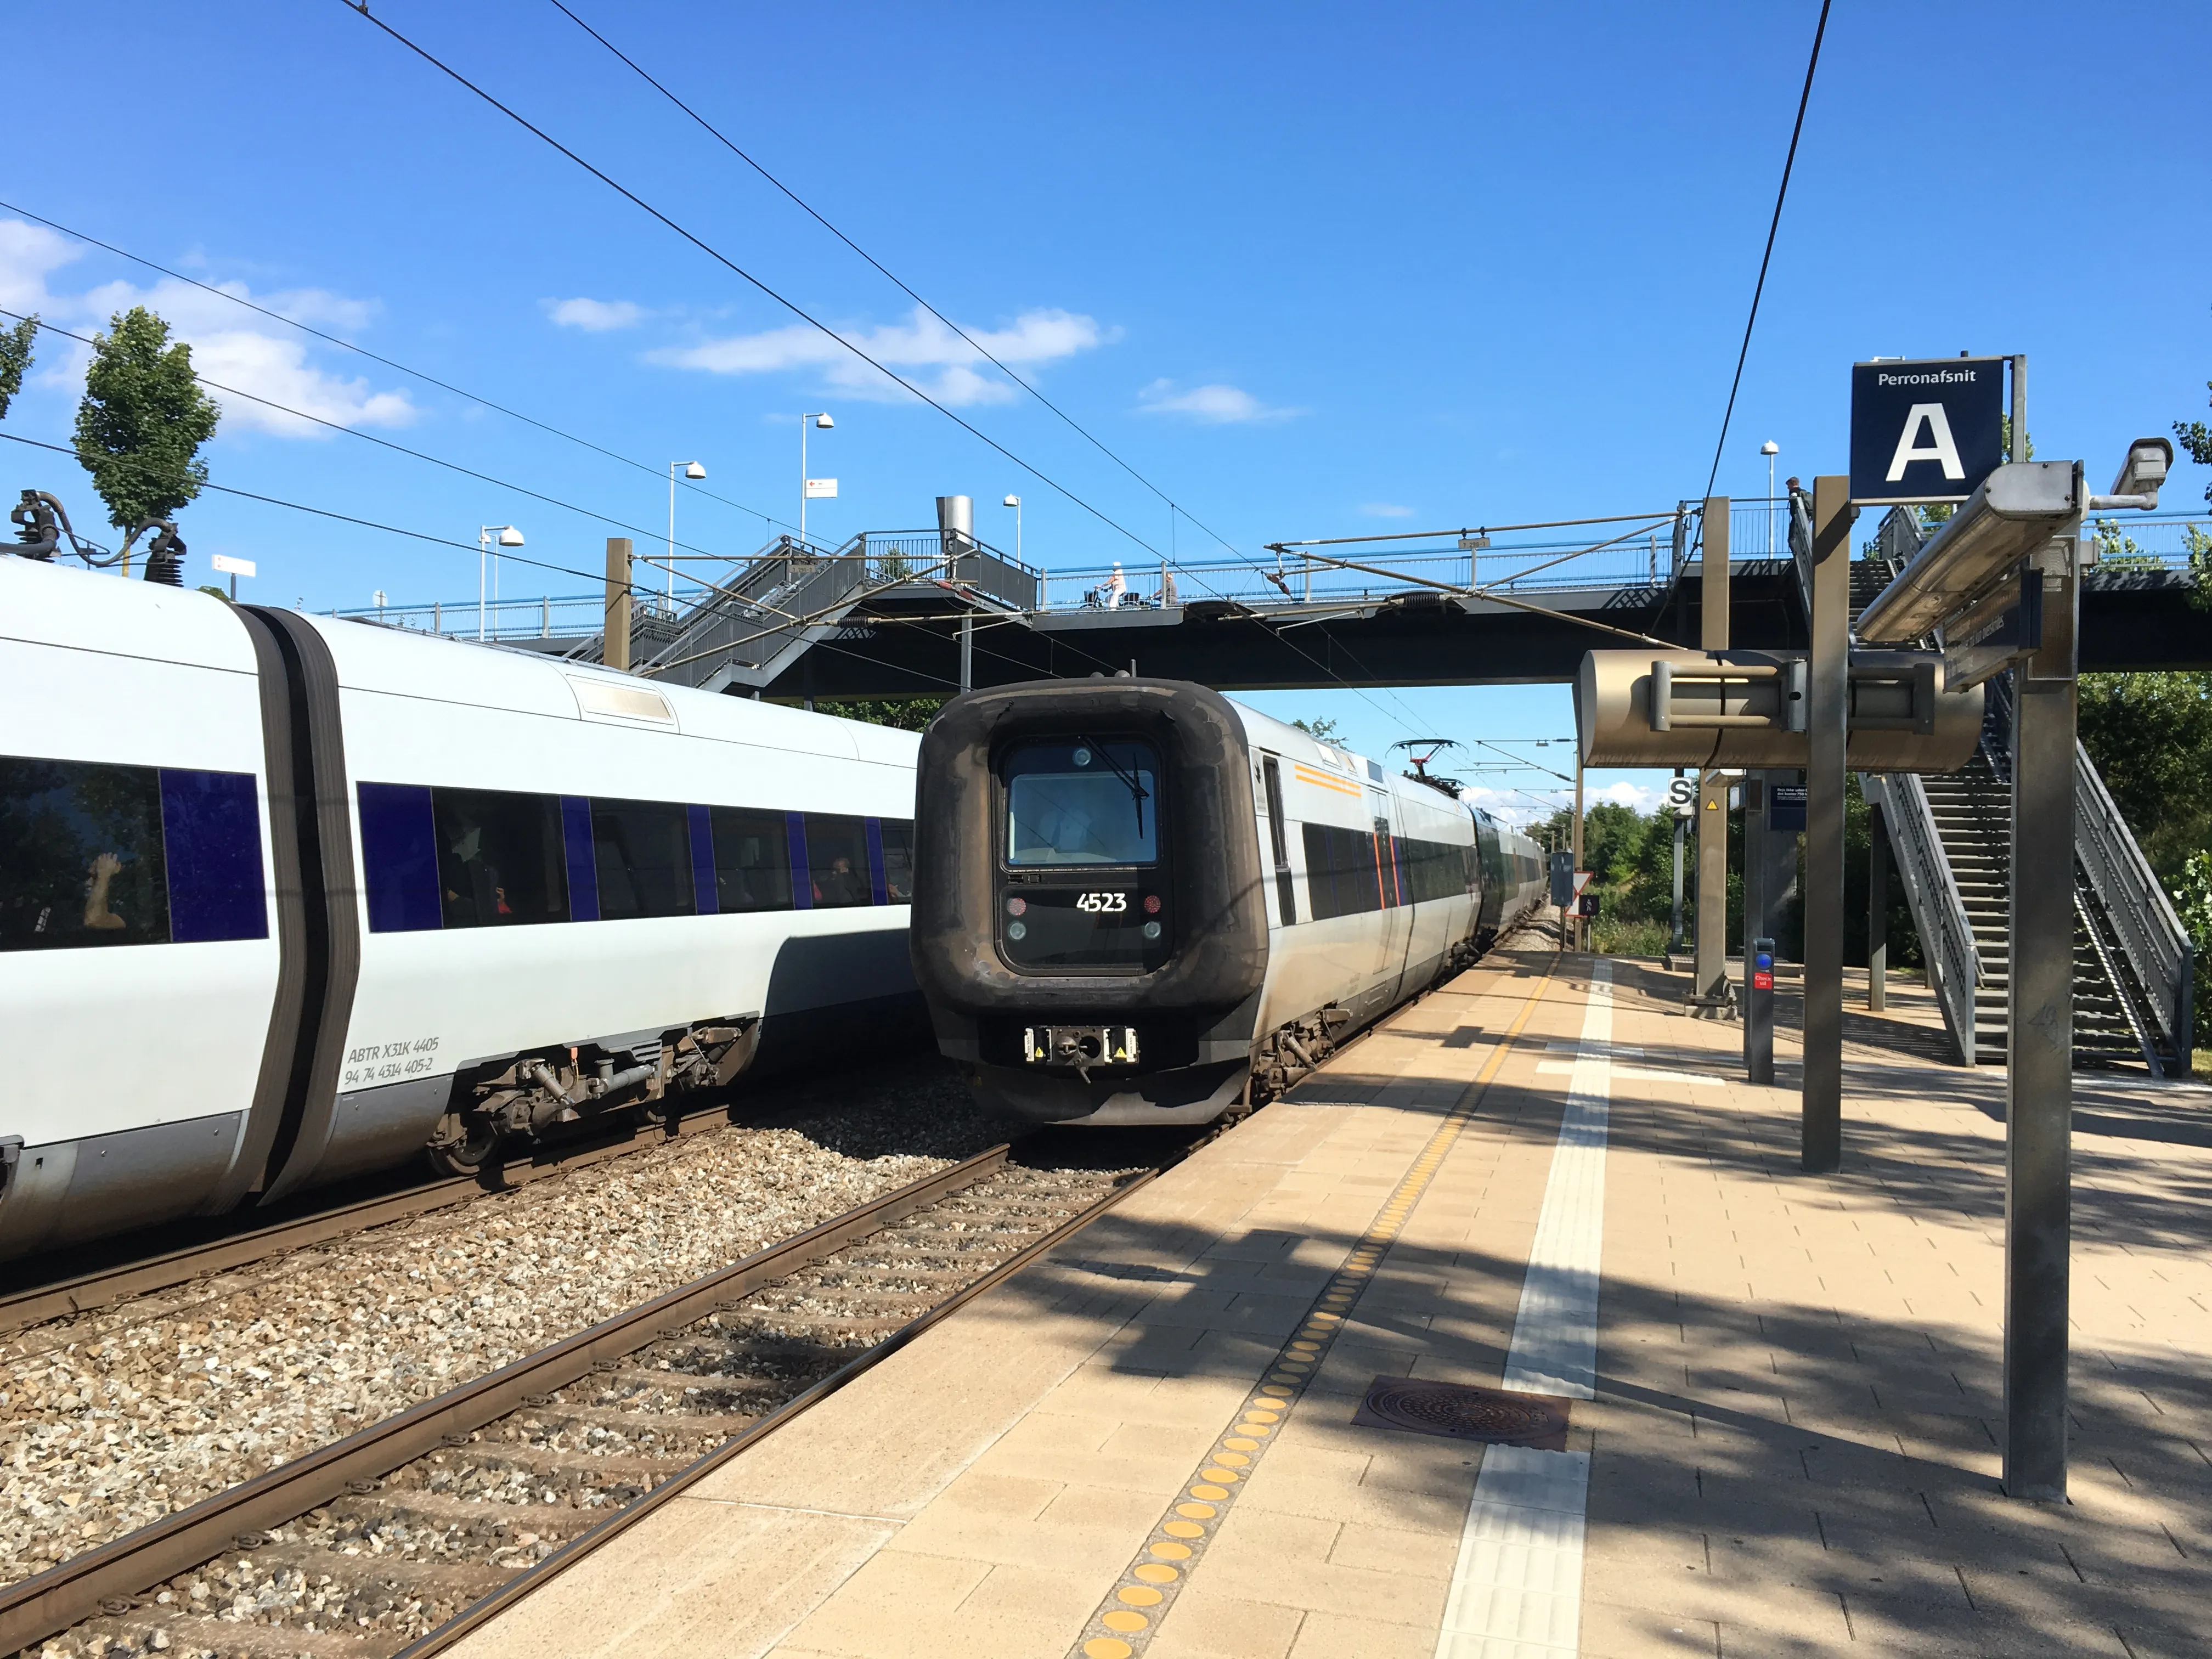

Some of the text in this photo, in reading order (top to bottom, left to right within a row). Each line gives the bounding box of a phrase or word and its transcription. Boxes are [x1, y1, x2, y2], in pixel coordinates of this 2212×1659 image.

[1878, 369, 1976, 386] Perronafsnit
[1886, 403, 1966, 482] A
[1670, 780, 1692, 805] S
[1076, 893, 1127, 912] 4523
[347, 1037, 439, 1064] ABTR X31K 4405
[345, 1057, 433, 1085] 94 74 4314 405-2
